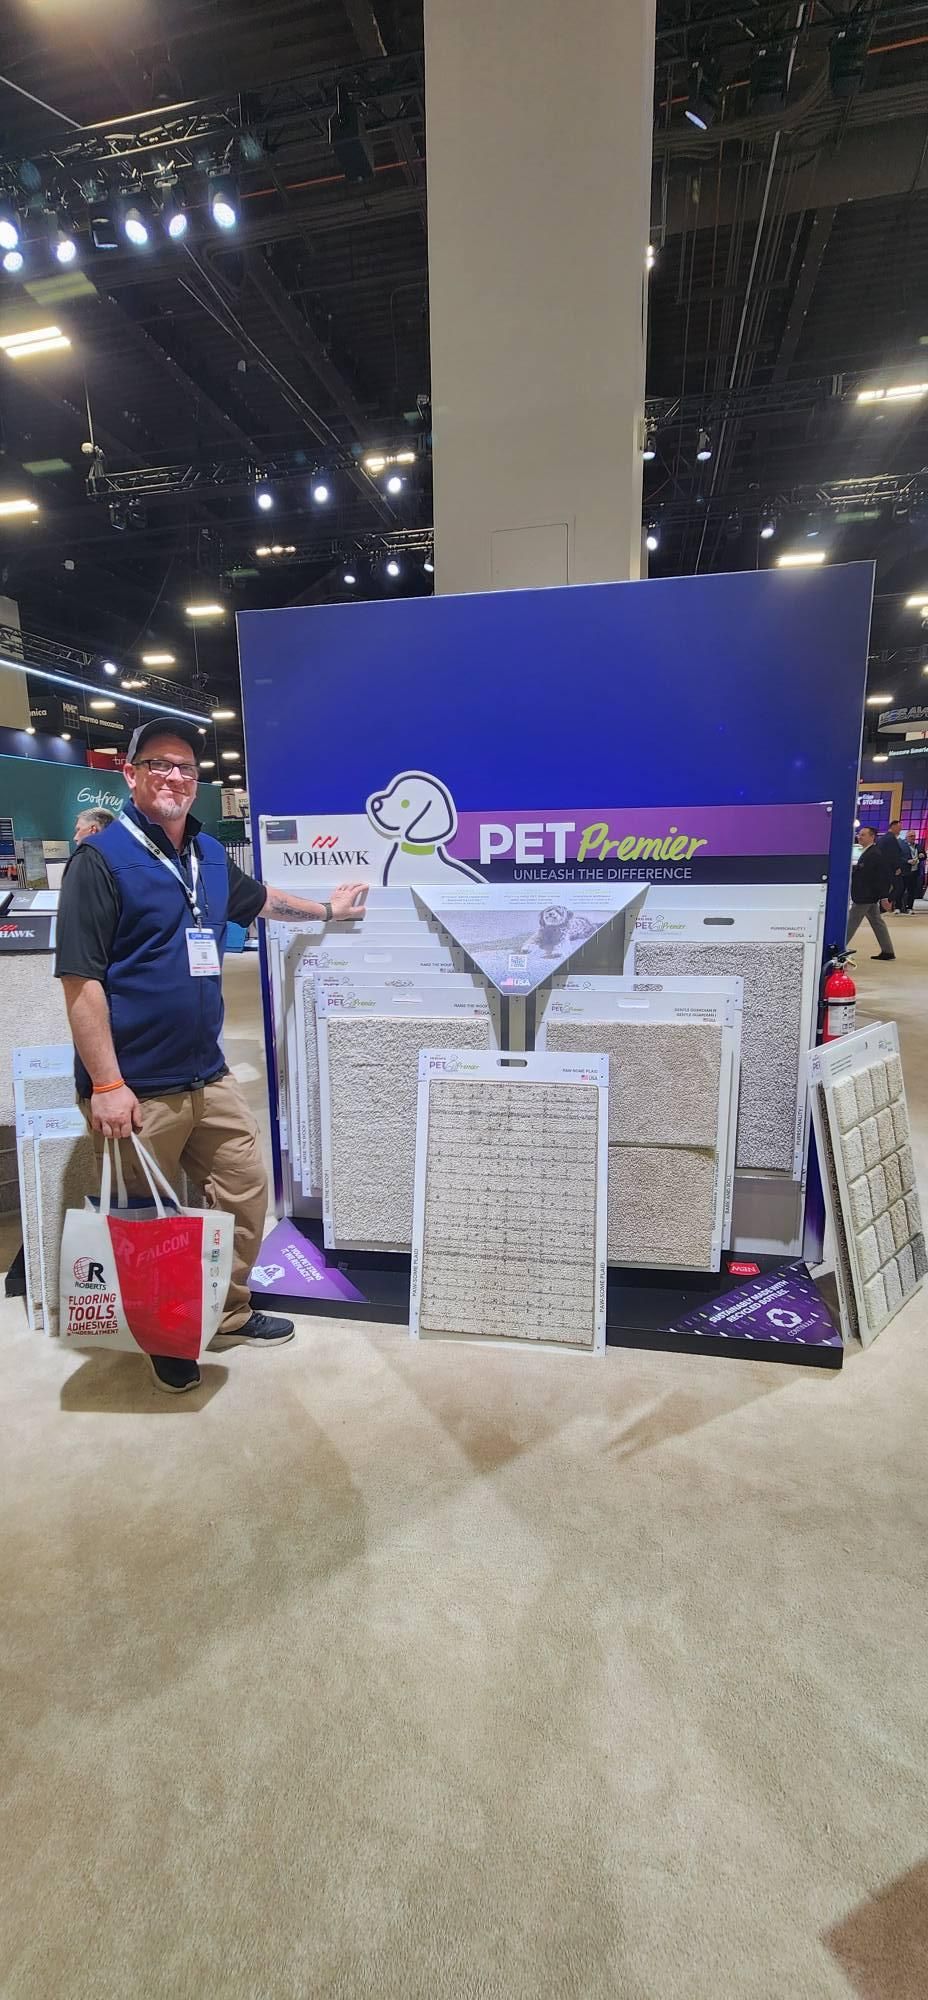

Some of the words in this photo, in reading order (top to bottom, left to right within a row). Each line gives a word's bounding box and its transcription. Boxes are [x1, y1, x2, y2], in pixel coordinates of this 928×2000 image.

[479, 822, 576, 864] PET
[576, 822, 708, 862] Premier
[283, 850, 370, 866] MOHAWK
[514, 869, 576, 880] UNLEASH
[578, 868, 604, 880] THE
[607, 868, 692, 880] DIFFERENCE
[328, 998, 344, 1006] PET
[430, 1062, 446, 1070] PET
[136, 1232, 190, 1268] FALCON
[87, 1262, 106, 1283] R
[74, 1280, 107, 1290] ROBERTS
[68, 1293, 116, 1306] FLOORING
[709, 1298, 754, 1323] SUSTAINABLY
[750, 1288, 773, 1300] MADE
[769, 1280, 790, 1290] WITH
[726, 1302, 762, 1322] RECYCLED
[67, 1320, 118, 1332] ADHESIVES
